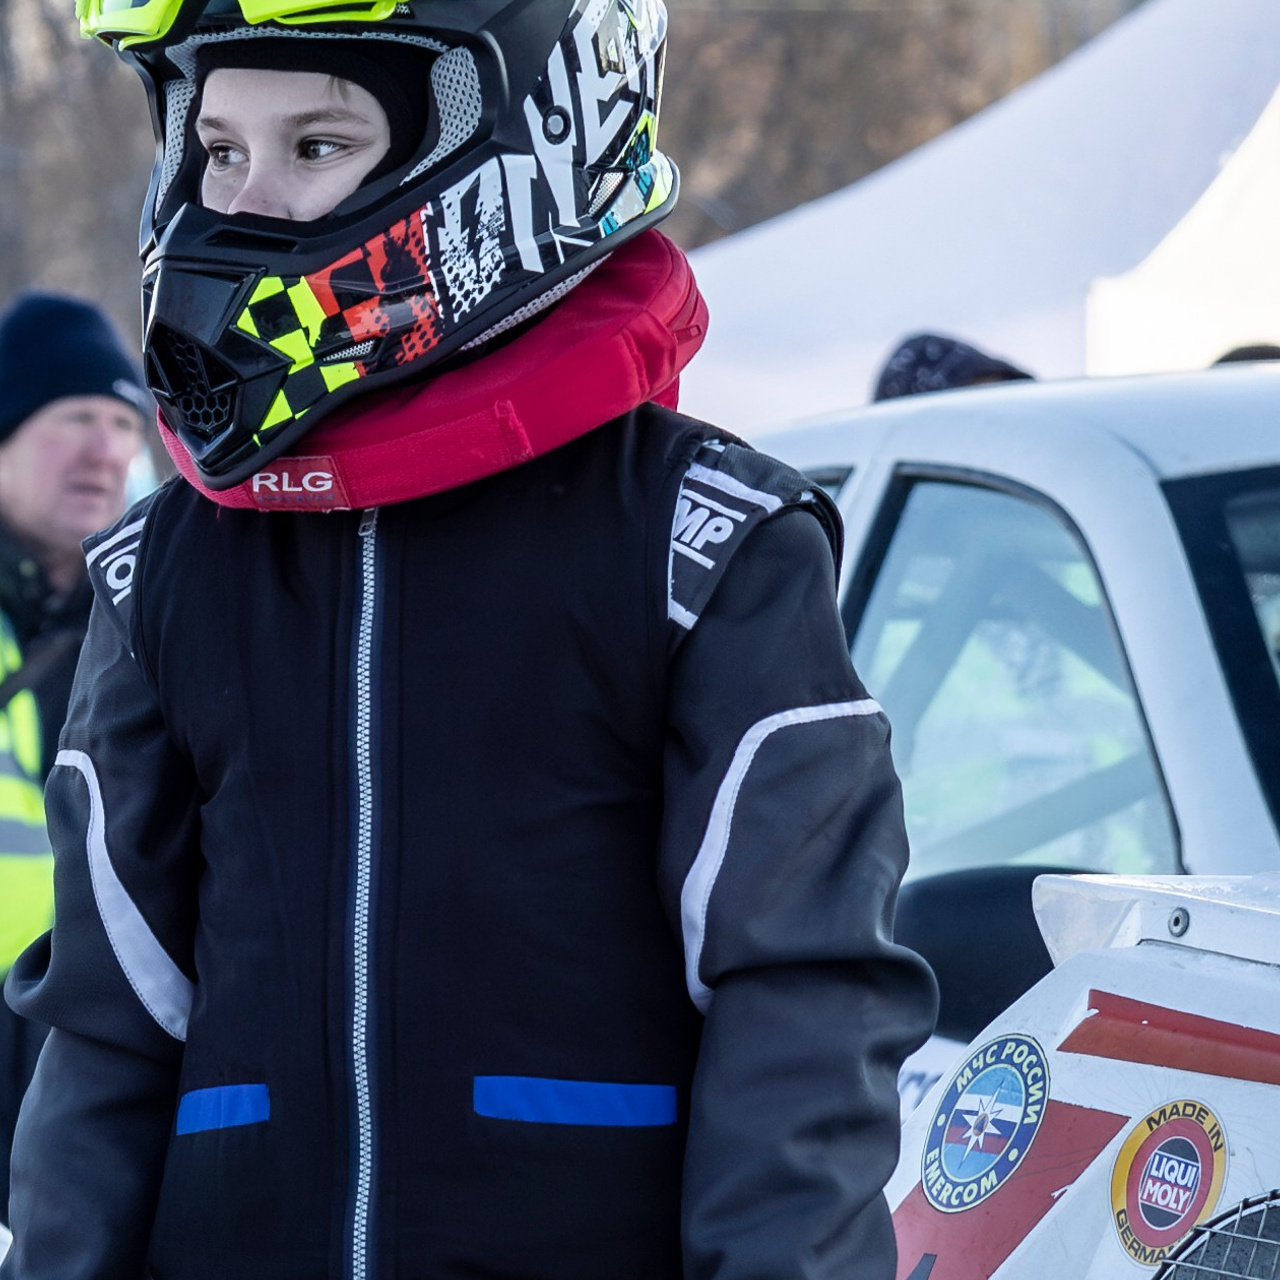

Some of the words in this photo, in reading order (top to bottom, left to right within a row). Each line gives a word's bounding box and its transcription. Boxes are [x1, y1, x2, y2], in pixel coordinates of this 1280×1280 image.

[252, 471, 334, 493] RLG
[956, 1044, 998, 1093] МЧС
[1001, 1041, 1044, 1124] РОССИИ
[1146, 1102, 1209, 1132] MADE
[1208, 1123, 1224, 1152] IN
[925, 1147, 998, 1205] EMERCOM
[1142, 1180, 1191, 1211] MOLY
[1151, 1155, 1197, 1188] LIQUI
[1116, 1208, 1175, 1264] GERMA
